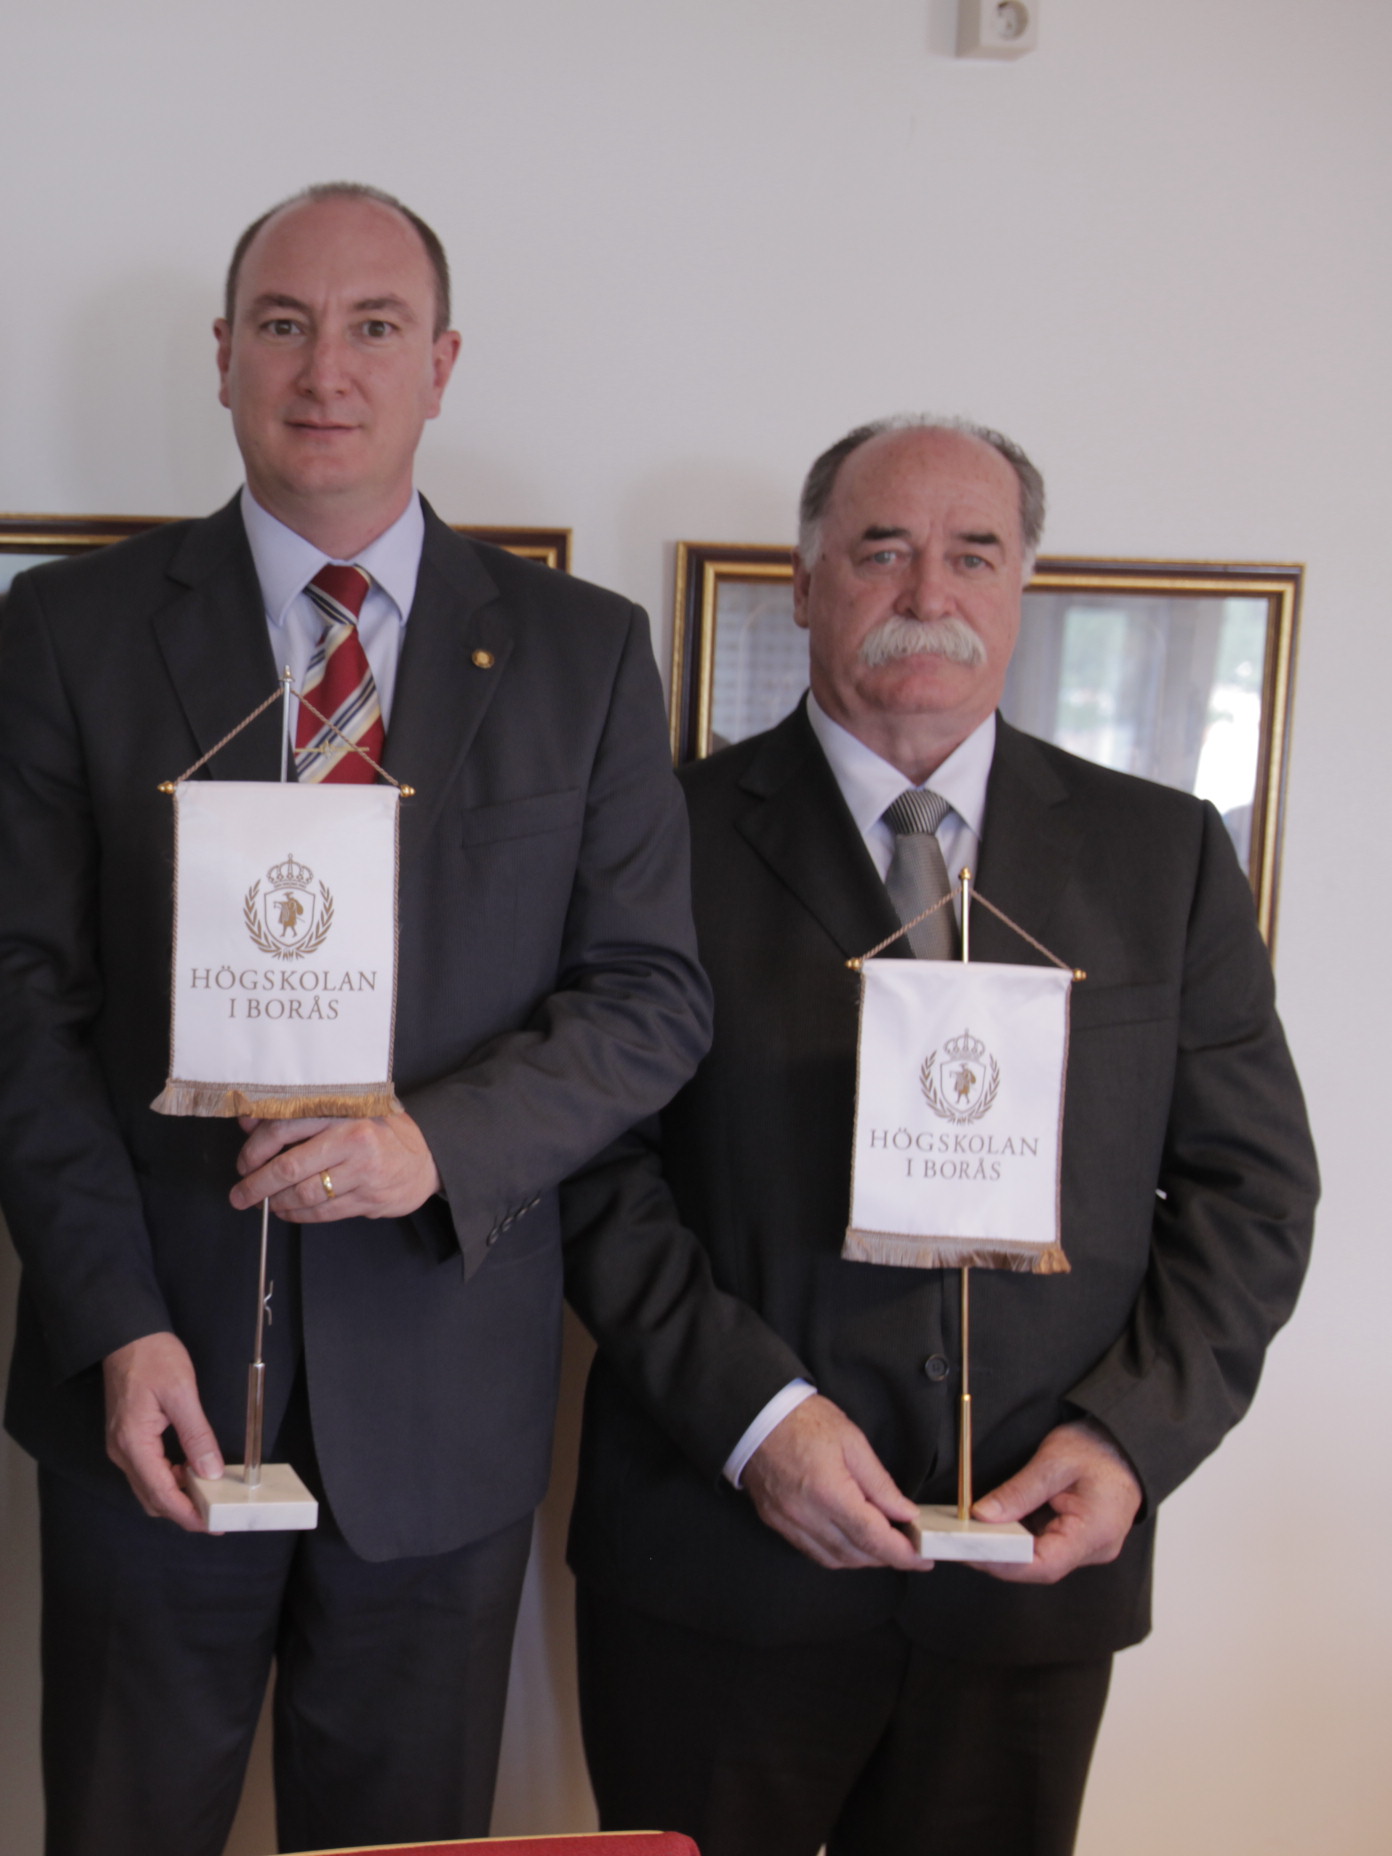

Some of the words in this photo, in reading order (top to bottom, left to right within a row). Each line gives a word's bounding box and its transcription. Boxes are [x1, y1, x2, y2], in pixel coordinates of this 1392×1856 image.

[190, 965, 378, 992] HÖGSKOLAN
[229, 998, 237, 1018] I
[246, 996, 339, 1020] BORÅS
[870, 1127, 1040, 1157] HÖGSKOLAN
[905, 1158, 913, 1177] I
[923, 1159, 1001, 1181] BORÅS
